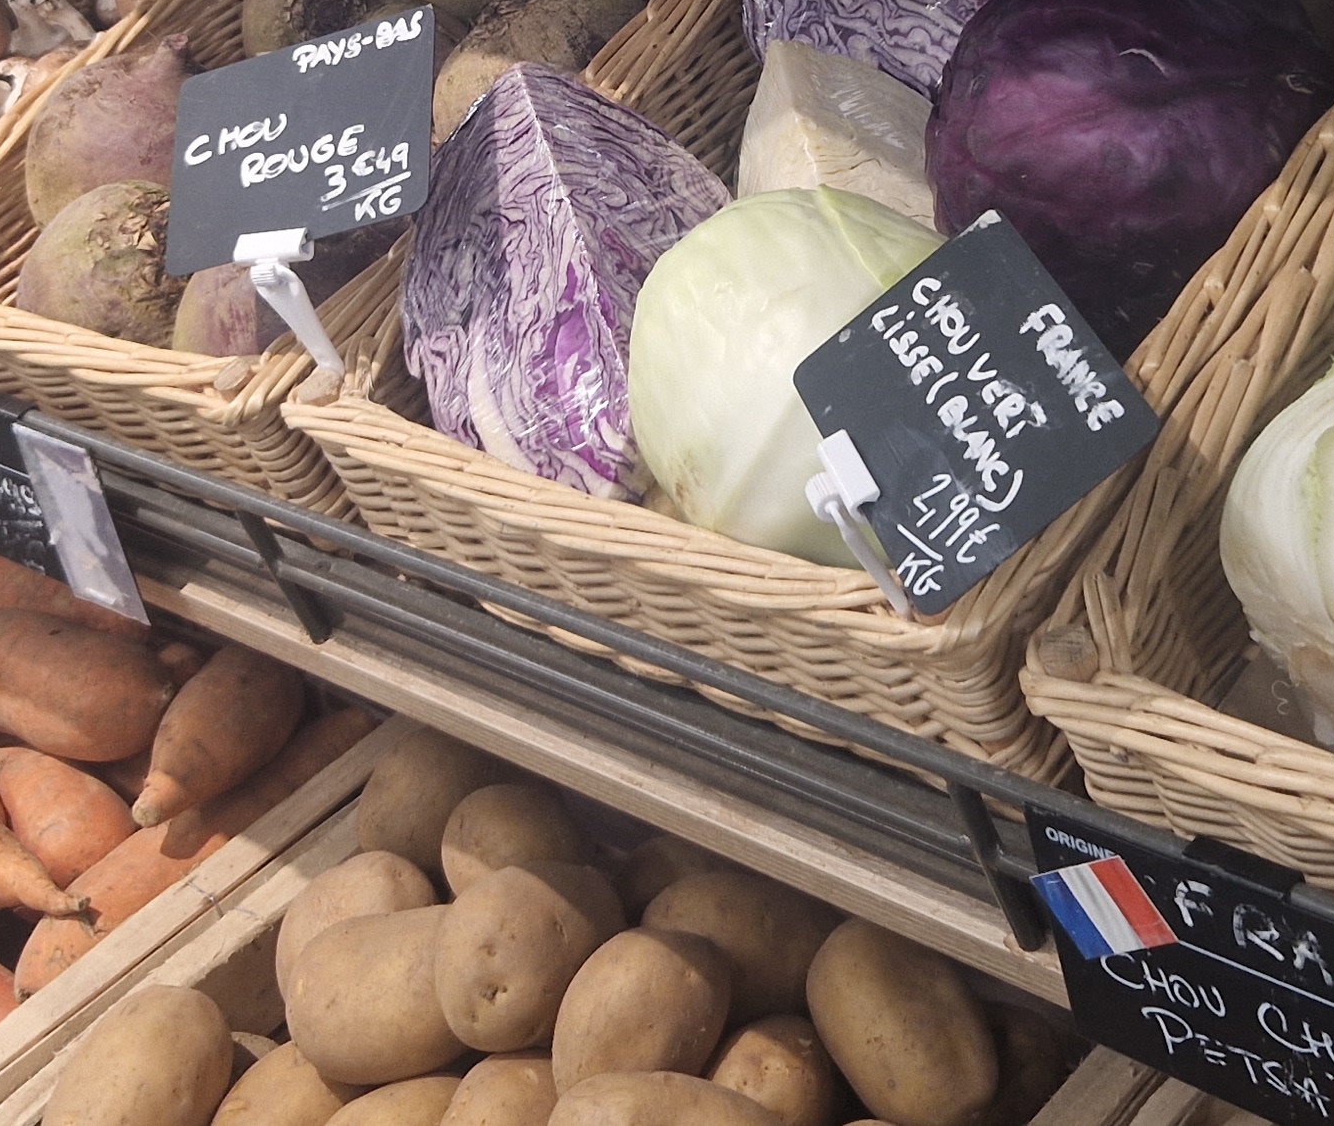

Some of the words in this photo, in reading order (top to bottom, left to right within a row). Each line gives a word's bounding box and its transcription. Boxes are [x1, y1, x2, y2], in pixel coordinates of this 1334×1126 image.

[291, 10, 423, 74] PAYS-BAS
[184, 113, 288, 166] CHOU
[240, 123, 365, 188] ROUGE
[354, 185, 403, 222] KG
[869, 304, 945, 387] LISSE
[911, 276, 981, 356] CHOU
[966, 352, 1049, 439] VERT
[1019, 302, 1127, 432] FRANCE
[897, 552, 946, 596] KG
[1100, 950, 1227, 1018] CHOU
